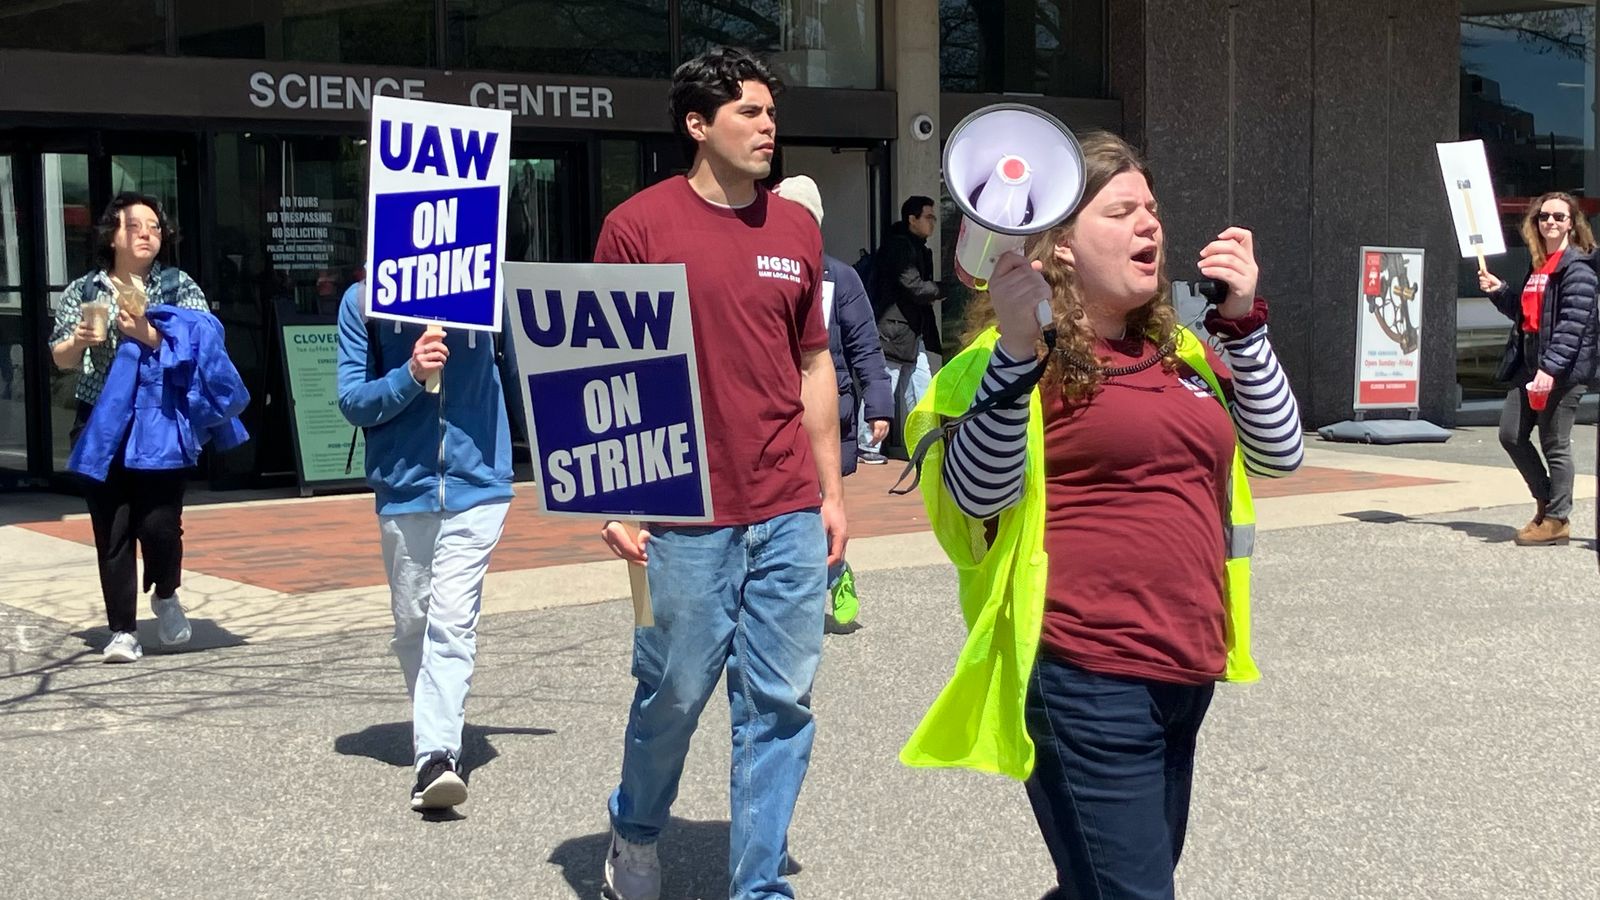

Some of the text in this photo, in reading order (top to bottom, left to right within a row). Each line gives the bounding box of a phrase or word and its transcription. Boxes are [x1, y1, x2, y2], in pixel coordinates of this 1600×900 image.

[249, 71, 613, 118] SCIENCE CENTER
[379, 119, 499, 181] UAW
[266, 212, 332, 223] NO TRESPASSING
[280, 196, 319, 208] NO TOURS
[412, 197, 458, 249] ON
[272, 227, 328, 238] NO SOLICITING
[376, 243, 492, 306] STRIKE
[756, 255, 801, 276] HGSU
[516, 288, 675, 350] UAW
[583, 371, 642, 434] ON
[547, 422, 693, 503] STRIKE
